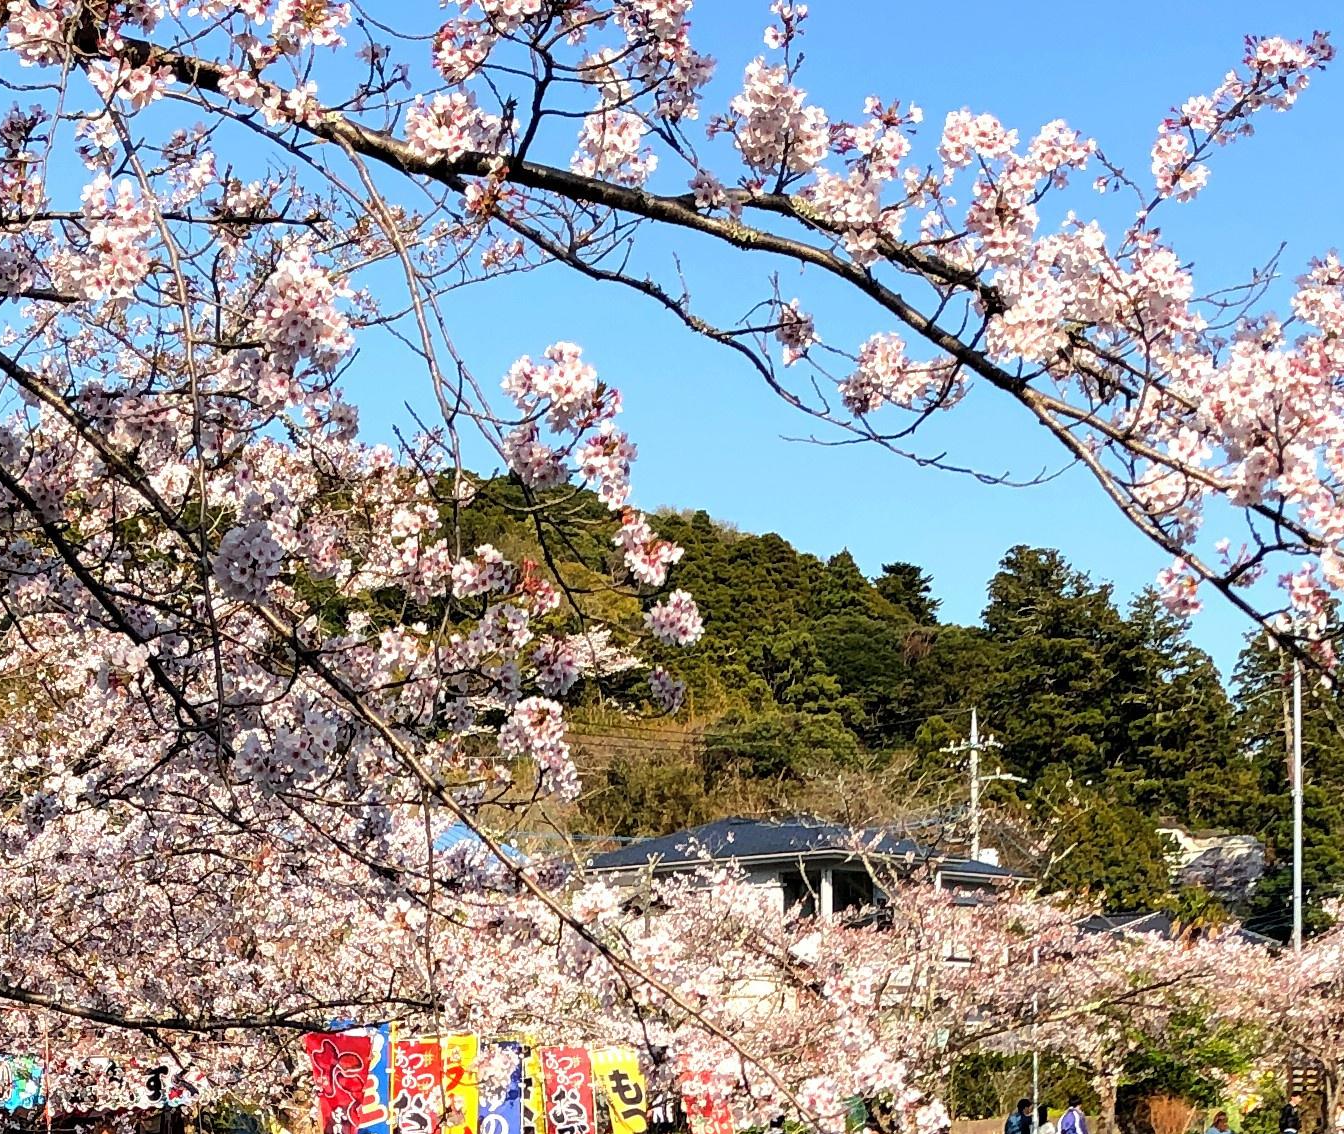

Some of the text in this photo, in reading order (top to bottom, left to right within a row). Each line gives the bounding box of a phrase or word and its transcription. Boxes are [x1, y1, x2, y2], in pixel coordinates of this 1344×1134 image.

[395, 1047, 424, 1068] あつ
[546, 1051, 573, 1069] あつ
[402, 1068, 434, 1089] あつ
